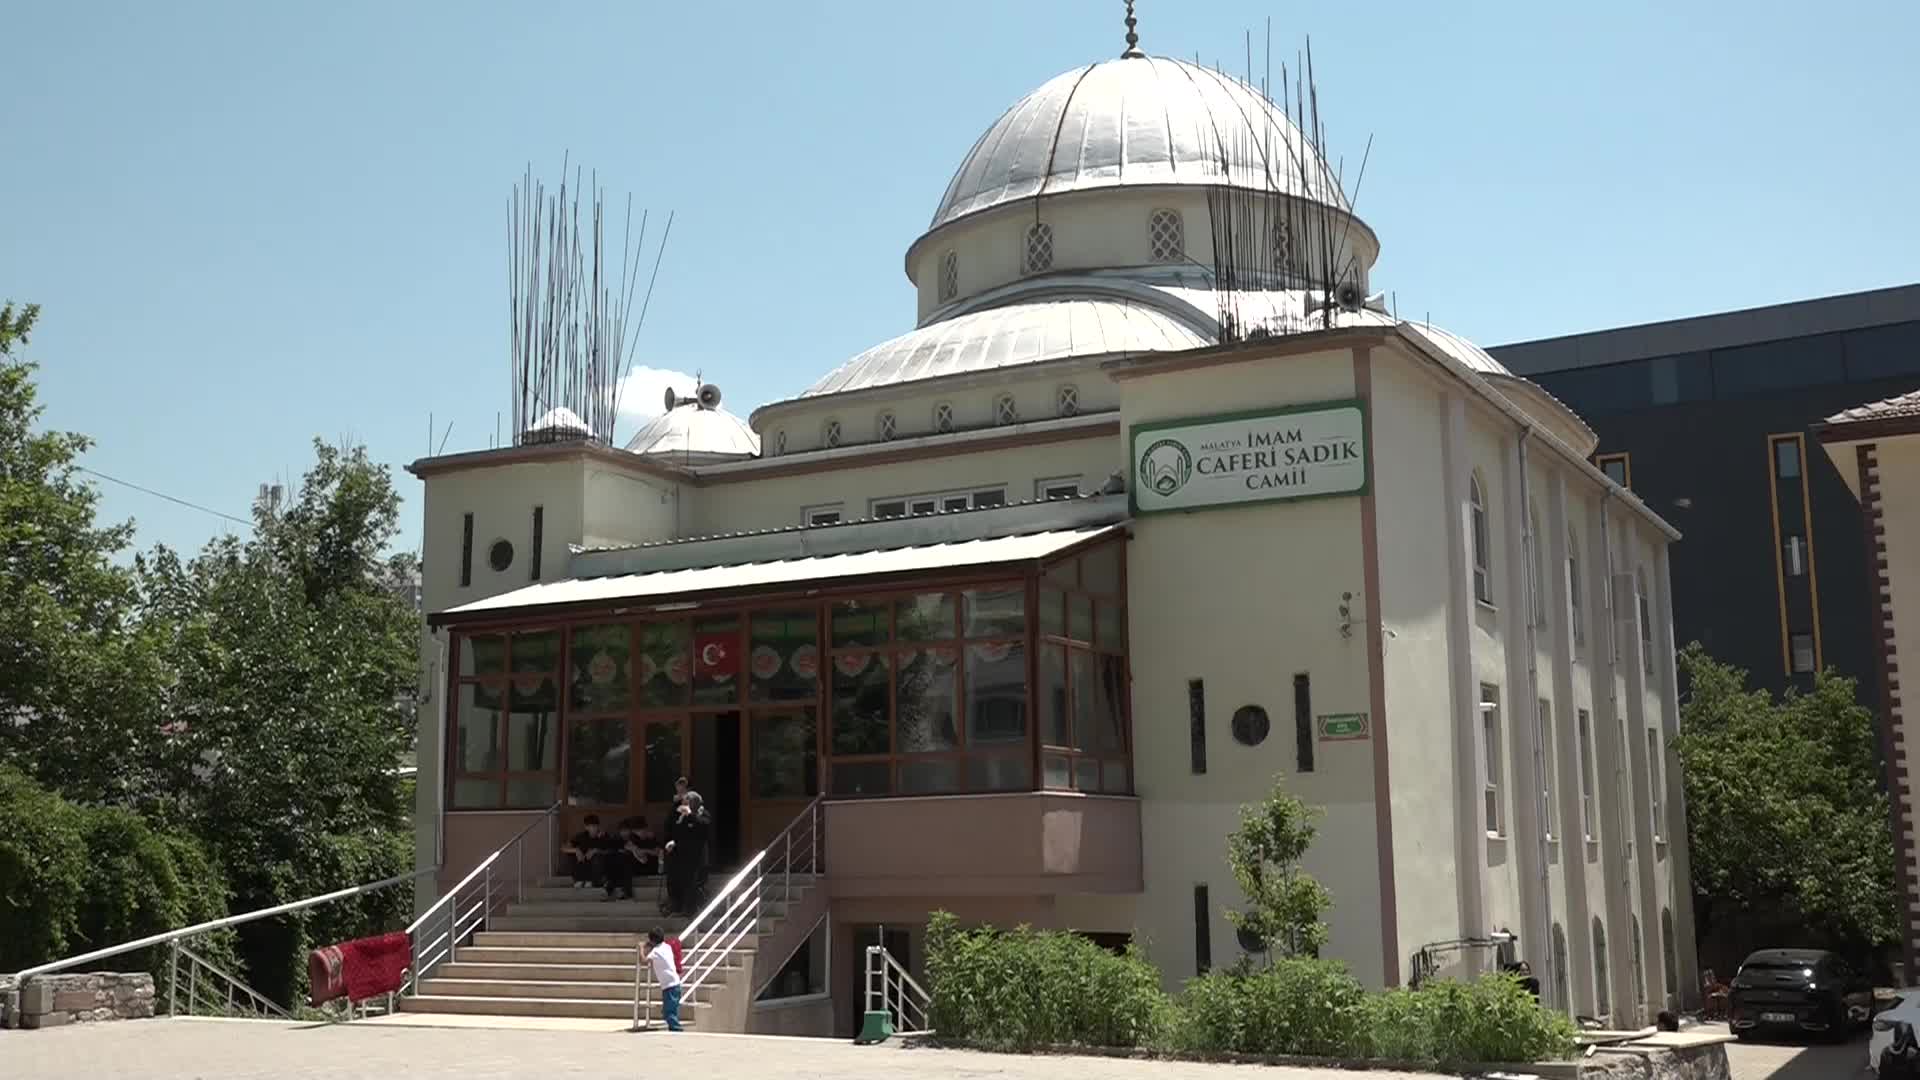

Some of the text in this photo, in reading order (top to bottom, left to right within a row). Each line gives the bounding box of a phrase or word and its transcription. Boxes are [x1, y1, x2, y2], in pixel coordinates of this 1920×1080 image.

[1201, 440, 1241, 450] MALATYA
[1197, 447, 1279, 474] CAFERİ
[1284, 441, 1359, 466] SADIK
